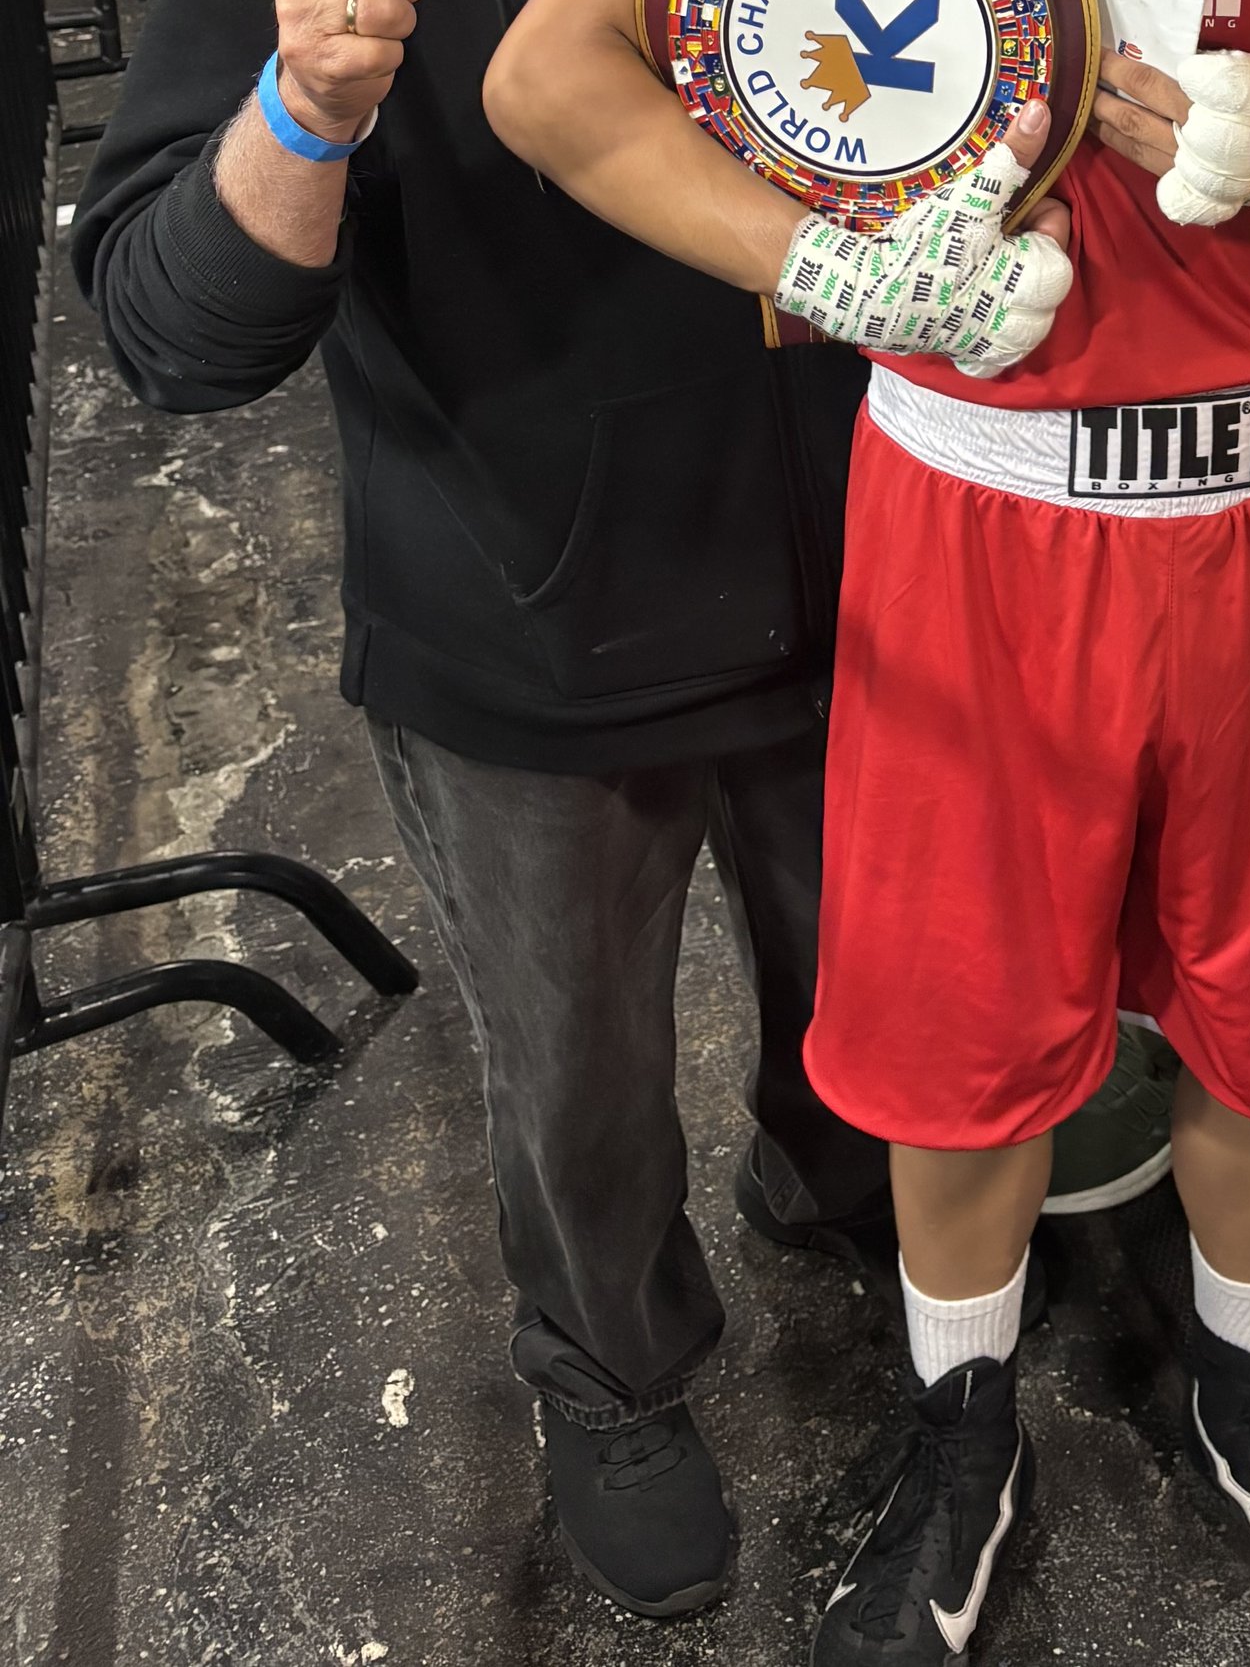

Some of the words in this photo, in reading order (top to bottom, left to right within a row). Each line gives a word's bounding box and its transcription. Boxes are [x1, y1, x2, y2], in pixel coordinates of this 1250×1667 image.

[746, 69, 867, 165] WORLD
[961, 193, 993, 212] WBC
[926, 231, 945, 260] WBC
[991, 249, 1011, 282] WBC
[820, 268, 840, 302] WBC
[880, 277, 907, 306] WBC
[911, 271, 935, 303] TITLE
[937, 277, 954, 306] WBC
[971, 289, 995, 323] TITLE
[1080, 401, 1241, 481] TITLE
[1091, 473, 1234, 491] BOXING
